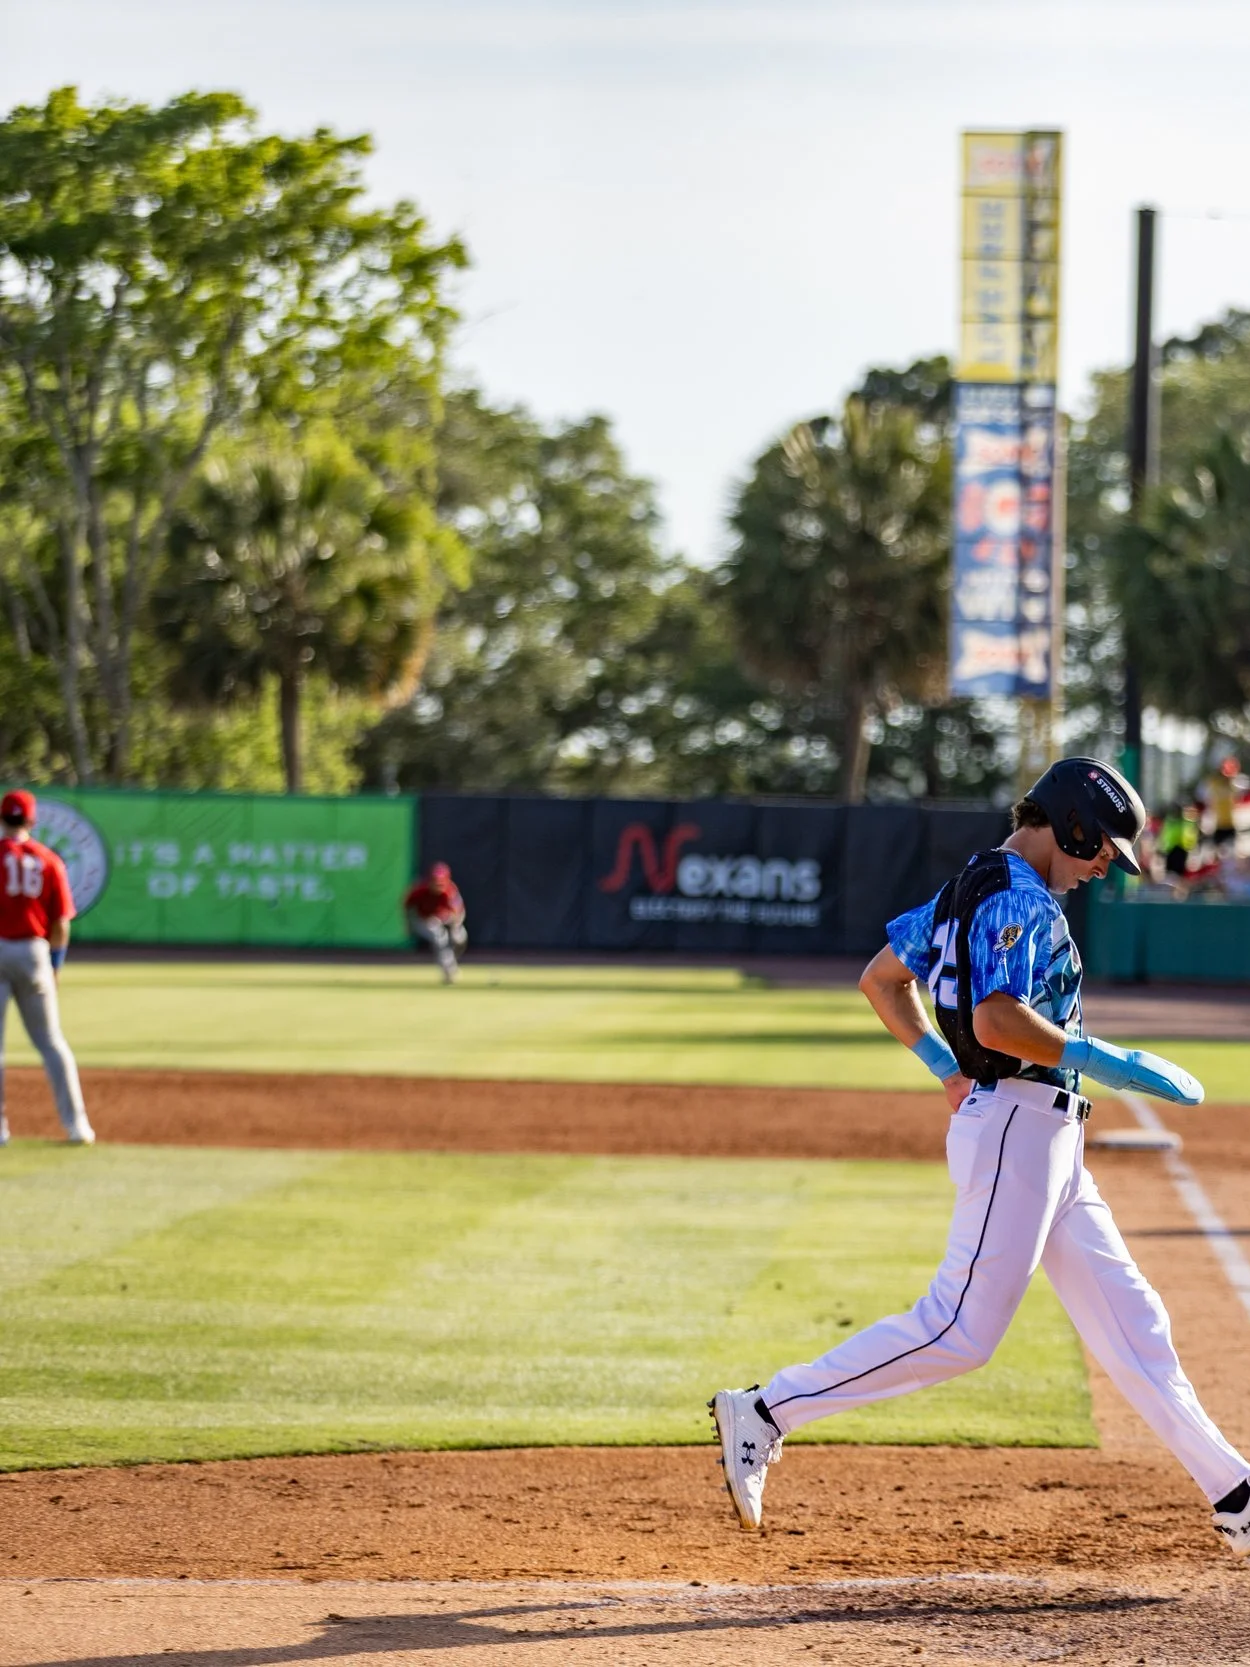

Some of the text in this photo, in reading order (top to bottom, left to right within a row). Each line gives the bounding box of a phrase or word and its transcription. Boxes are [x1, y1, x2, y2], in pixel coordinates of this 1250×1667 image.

[1096, 778, 1126, 813] STRAUSS
[193, 841, 214, 867] A
[228, 840, 367, 871] MATTER
[599, 822, 821, 902] Nexans
[5, 852, 44, 898] 16
[147, 871, 198, 898] OF
